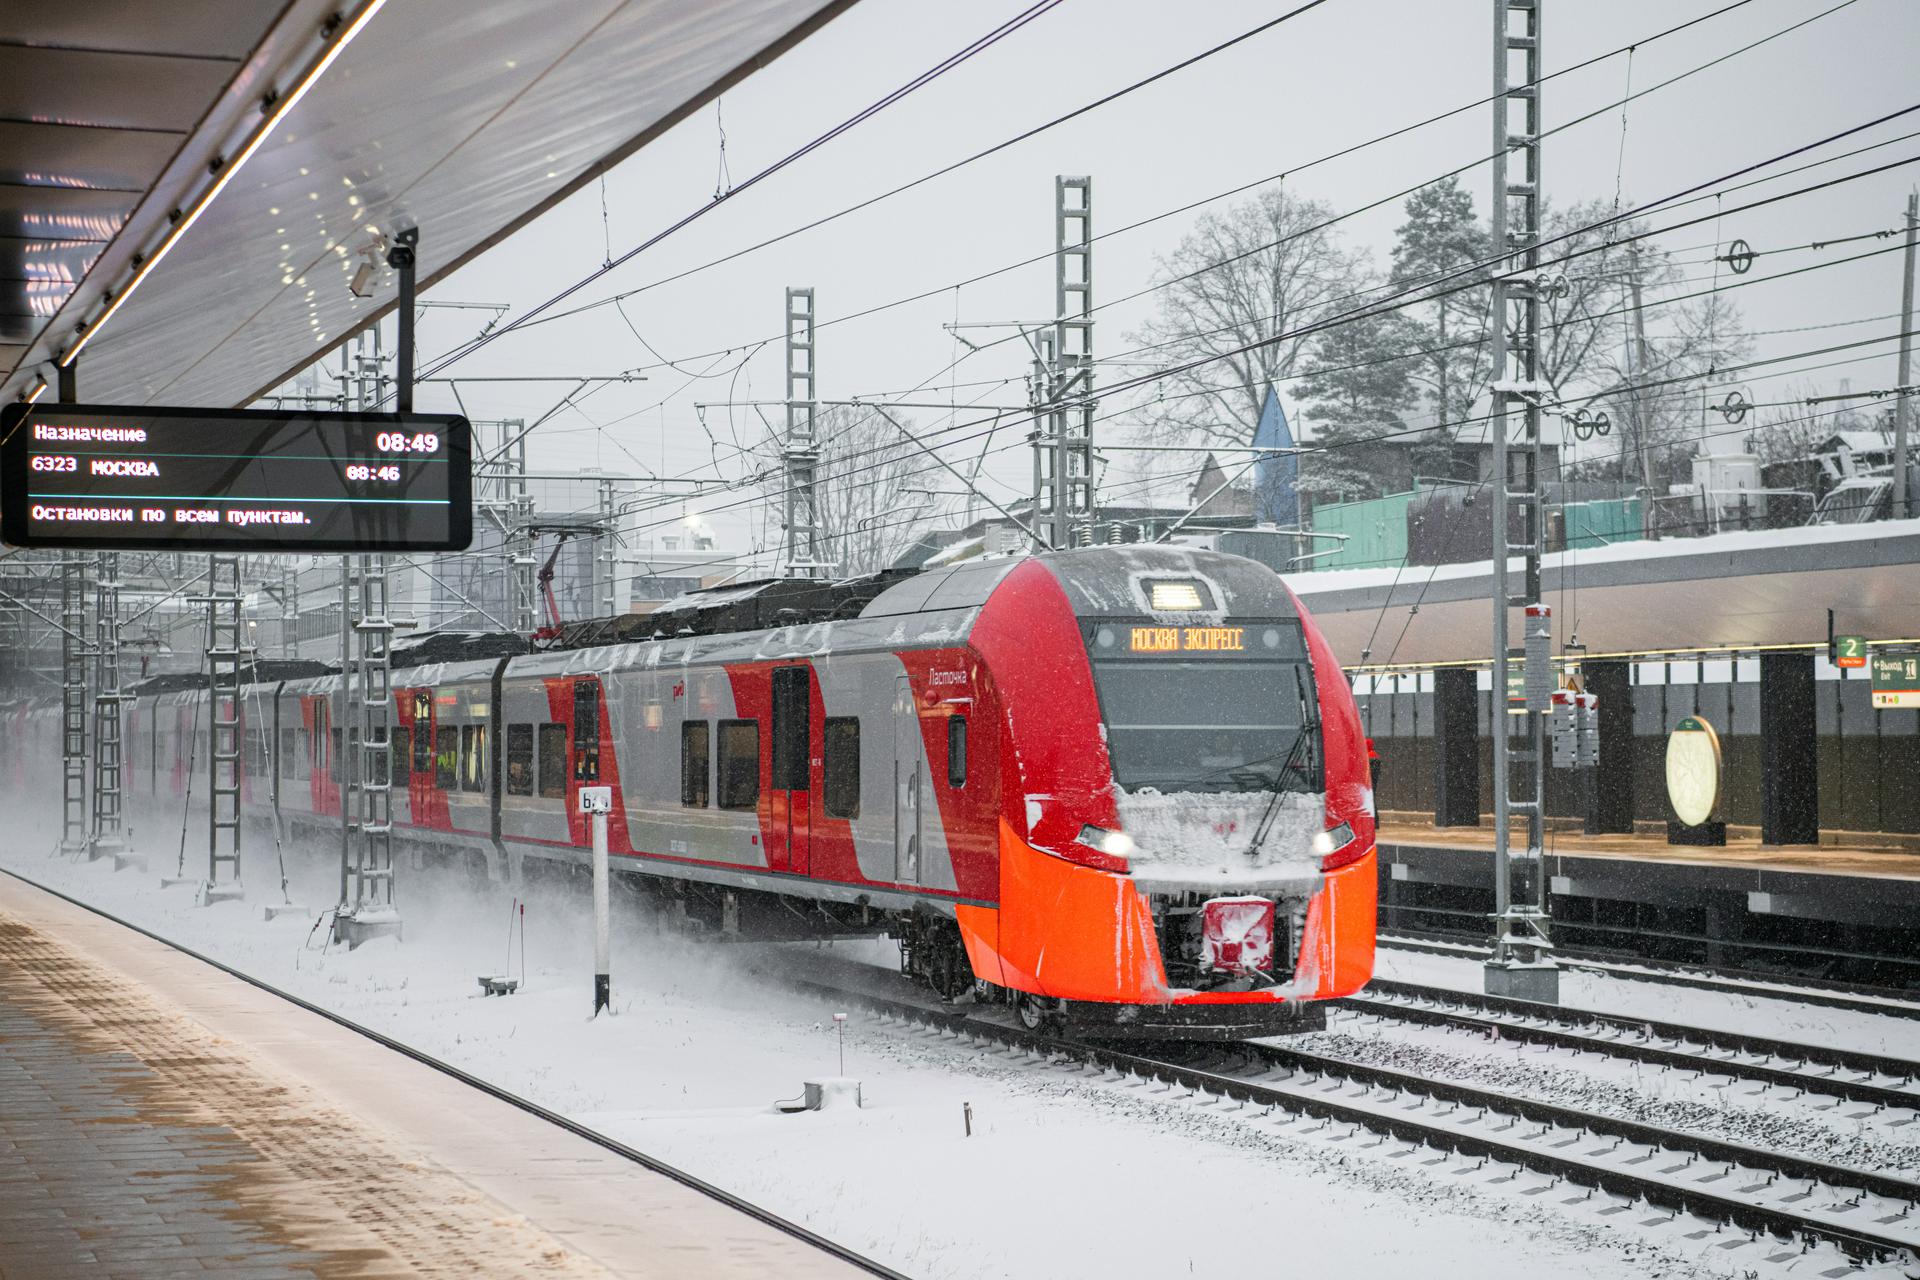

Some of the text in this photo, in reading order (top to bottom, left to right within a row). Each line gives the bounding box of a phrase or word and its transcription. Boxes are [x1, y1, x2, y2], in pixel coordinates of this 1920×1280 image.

[34, 425, 147, 442] Назначение
[377, 432, 439, 453] 08:49
[32, 456, 160, 477] 6323 МОСКВА
[32, 505, 311, 526] Остановки по всем пунктам.
[1131, 627, 1244, 651] МОСКВА ЭКСПРЕСС
[1845, 638, 1857, 657] 2
[928, 667, 967, 686] Ласточка
[1880, 660, 1903, 673] Выход
